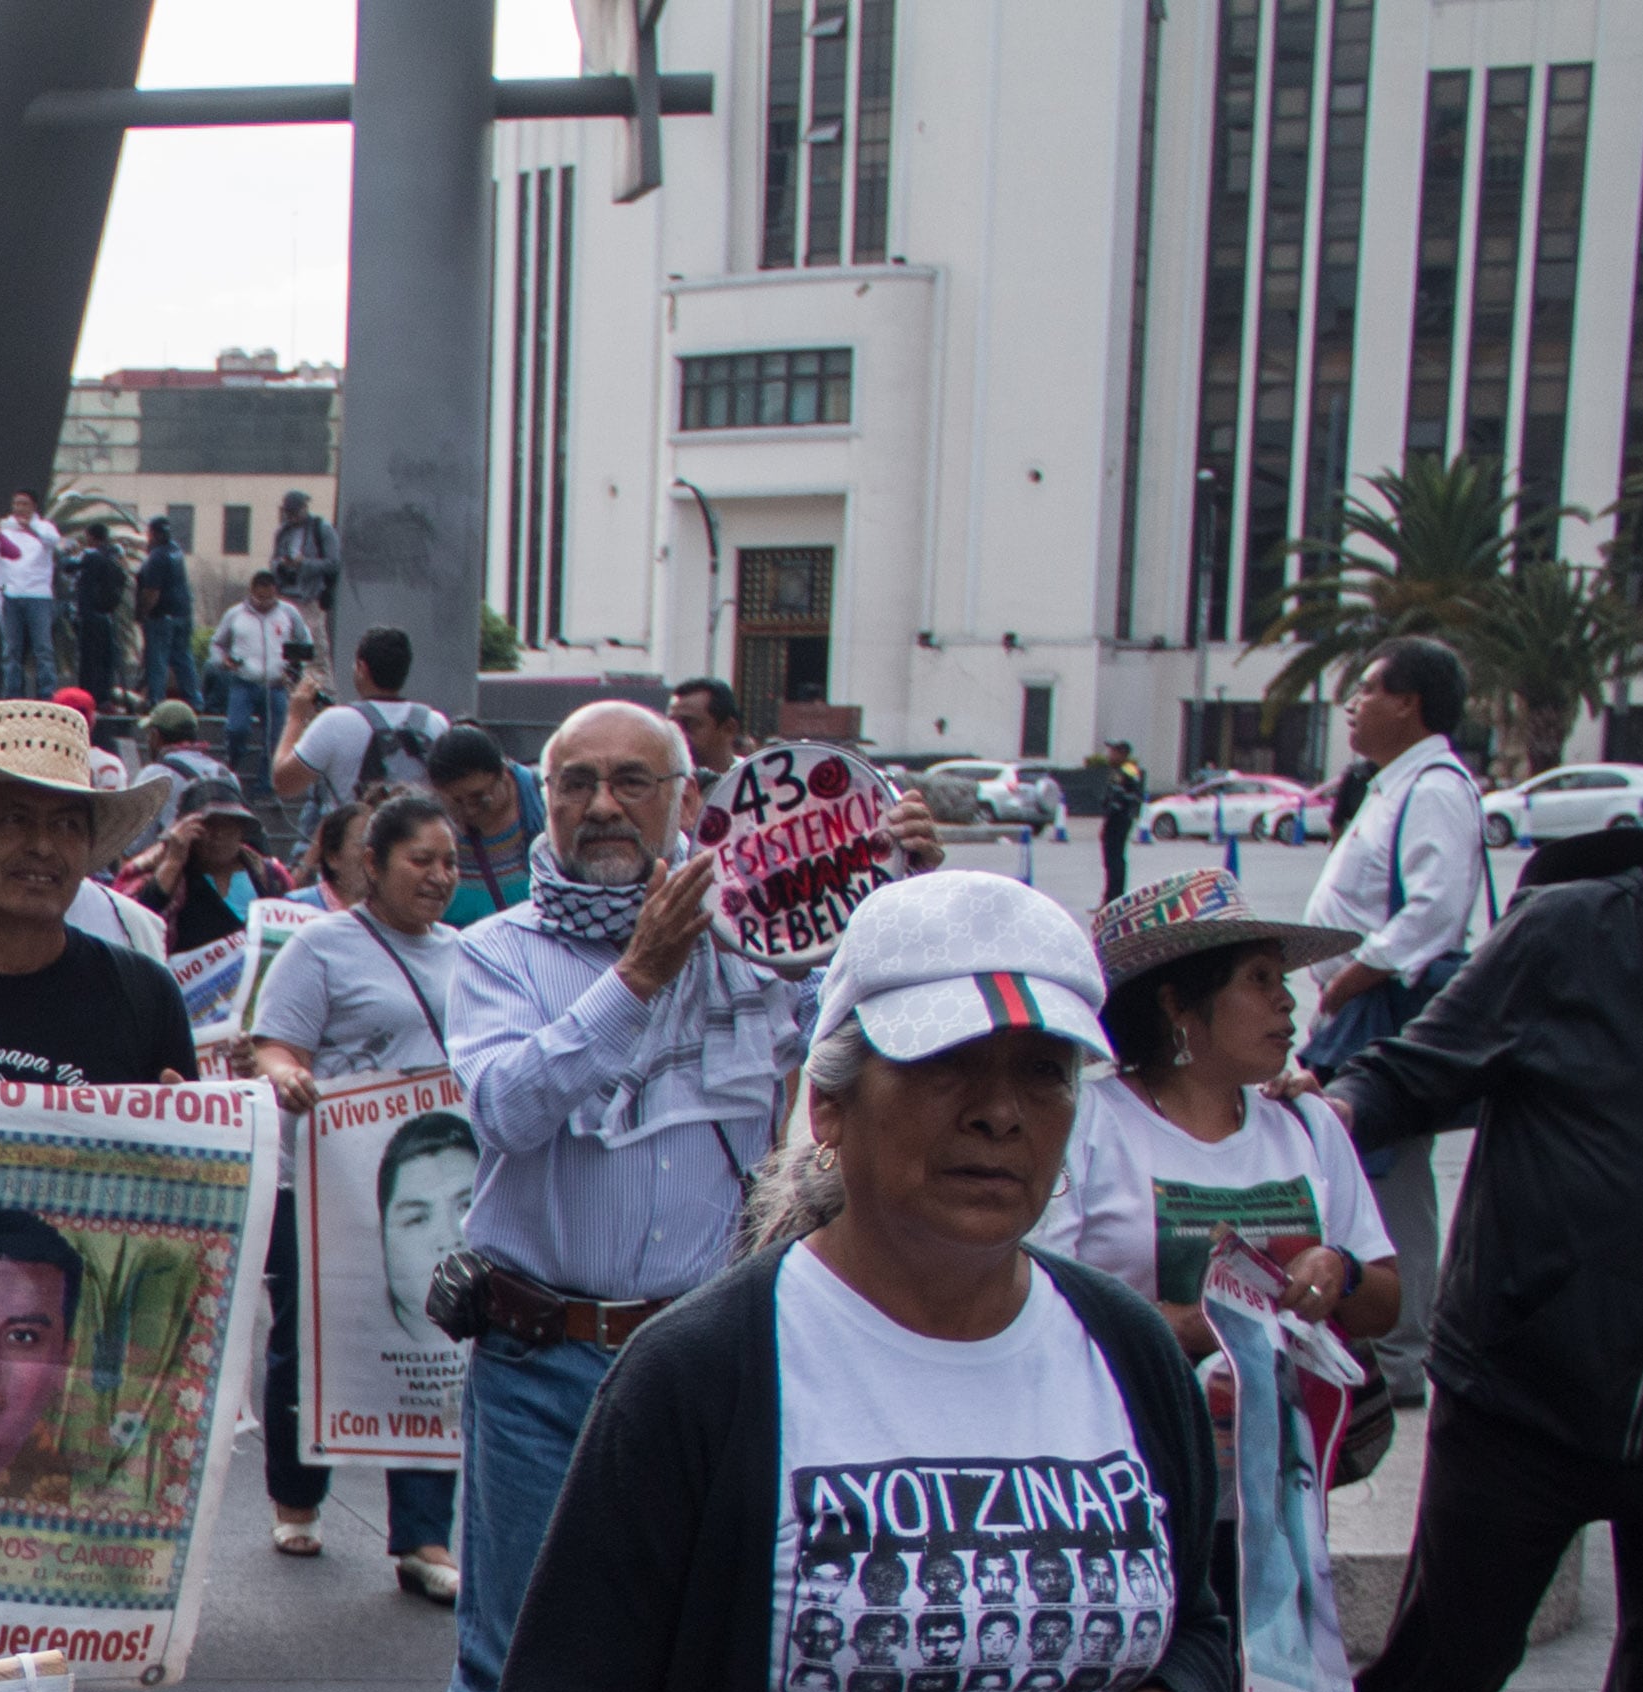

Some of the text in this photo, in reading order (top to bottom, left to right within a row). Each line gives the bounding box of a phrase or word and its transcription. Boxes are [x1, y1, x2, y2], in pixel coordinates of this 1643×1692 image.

[730, 750, 807, 824] 43
[717, 784, 884, 881] ESISTENCIA
[204, 944, 227, 965] se
[320, 1096, 381, 1136] ¡Vivo
[384, 1093, 411, 1120] se
[413, 1083, 435, 1114] lo
[330, 1410, 444, 1439] ¡Con VIDA
[54, 1541, 156, 1571] CANTOR
